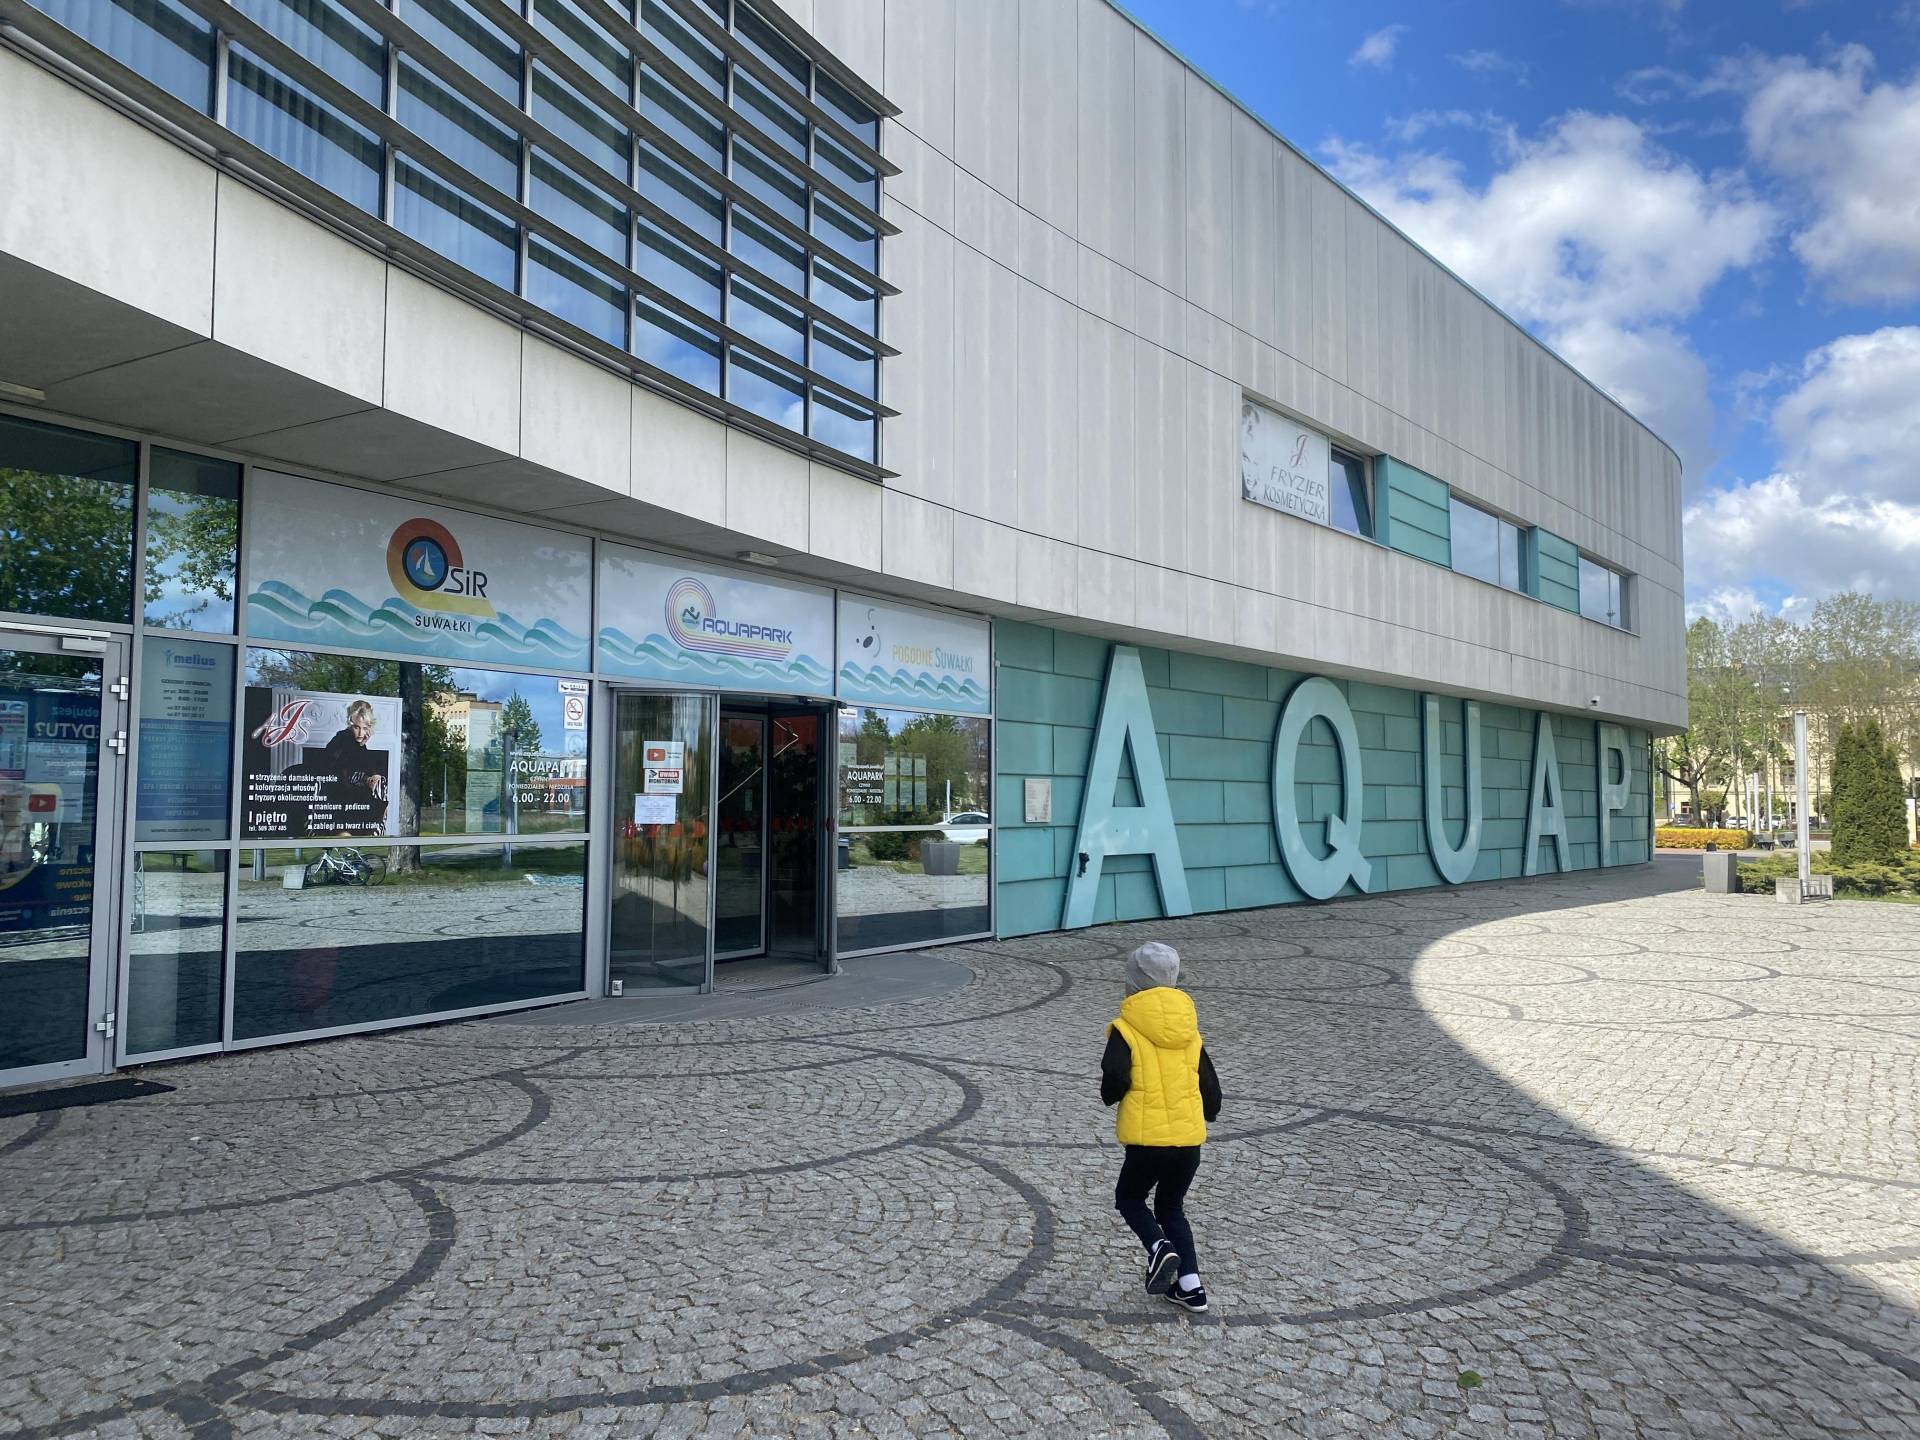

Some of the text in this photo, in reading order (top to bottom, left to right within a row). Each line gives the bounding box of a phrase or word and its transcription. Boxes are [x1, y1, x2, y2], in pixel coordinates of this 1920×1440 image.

[1270, 466, 1325, 499] FRYZJER
[1263, 483, 1326, 521] KOSMETYCZKA
[414, 615, 471, 633] SUWAŁKI
[702, 617, 793, 645] AQUAPARK
[174, 654, 216, 667] melius
[892, 644, 934, 668] POGODNE
[847, 771, 884, 781] AQUAPARK
[254, 783, 291, 792] koloryzacja
[254, 793, 277, 803] fryzury
[512, 793, 533, 803] 6.00
[543, 792, 570, 803] 22.00
[866, 795, 882, 804] 22.00
[314, 803, 371, 812] manicure pedicure
[255, 810, 288, 826] piętro
[313, 822, 336, 831] zabiegi
